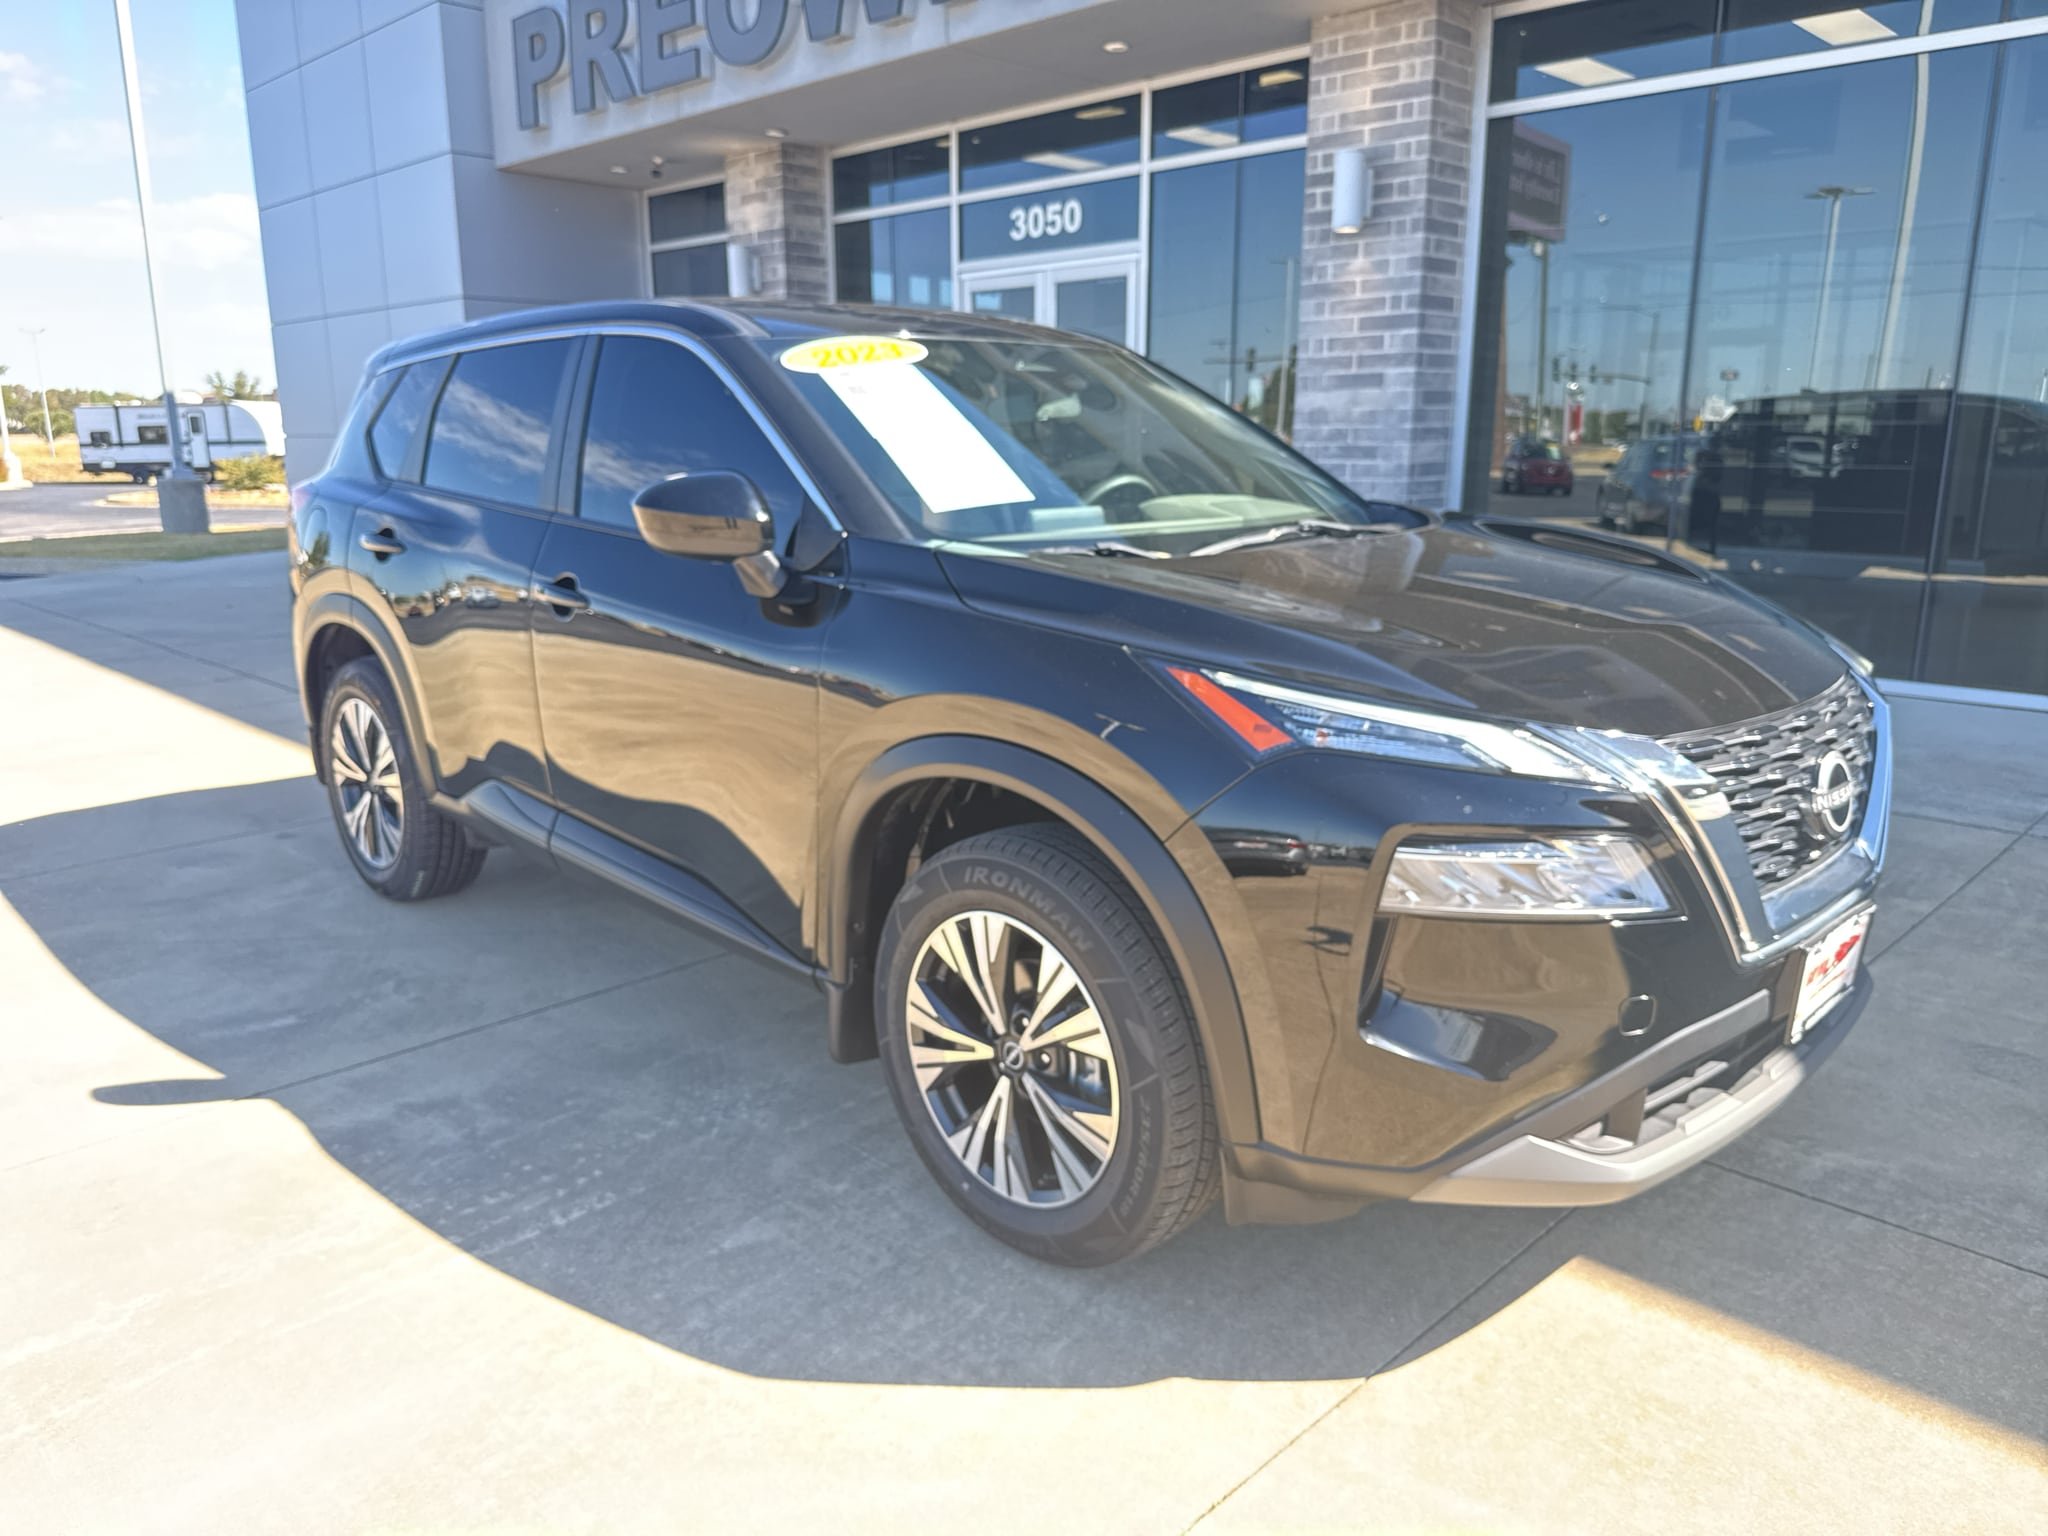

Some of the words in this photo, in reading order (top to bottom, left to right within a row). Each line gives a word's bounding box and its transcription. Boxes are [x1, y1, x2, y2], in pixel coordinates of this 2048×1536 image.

[513, 0, 948, 130] PREO
[1009, 199, 1083, 241] 3050
[811, 342, 903, 367] 2023
[964, 866, 1094, 951] IRONMAN
